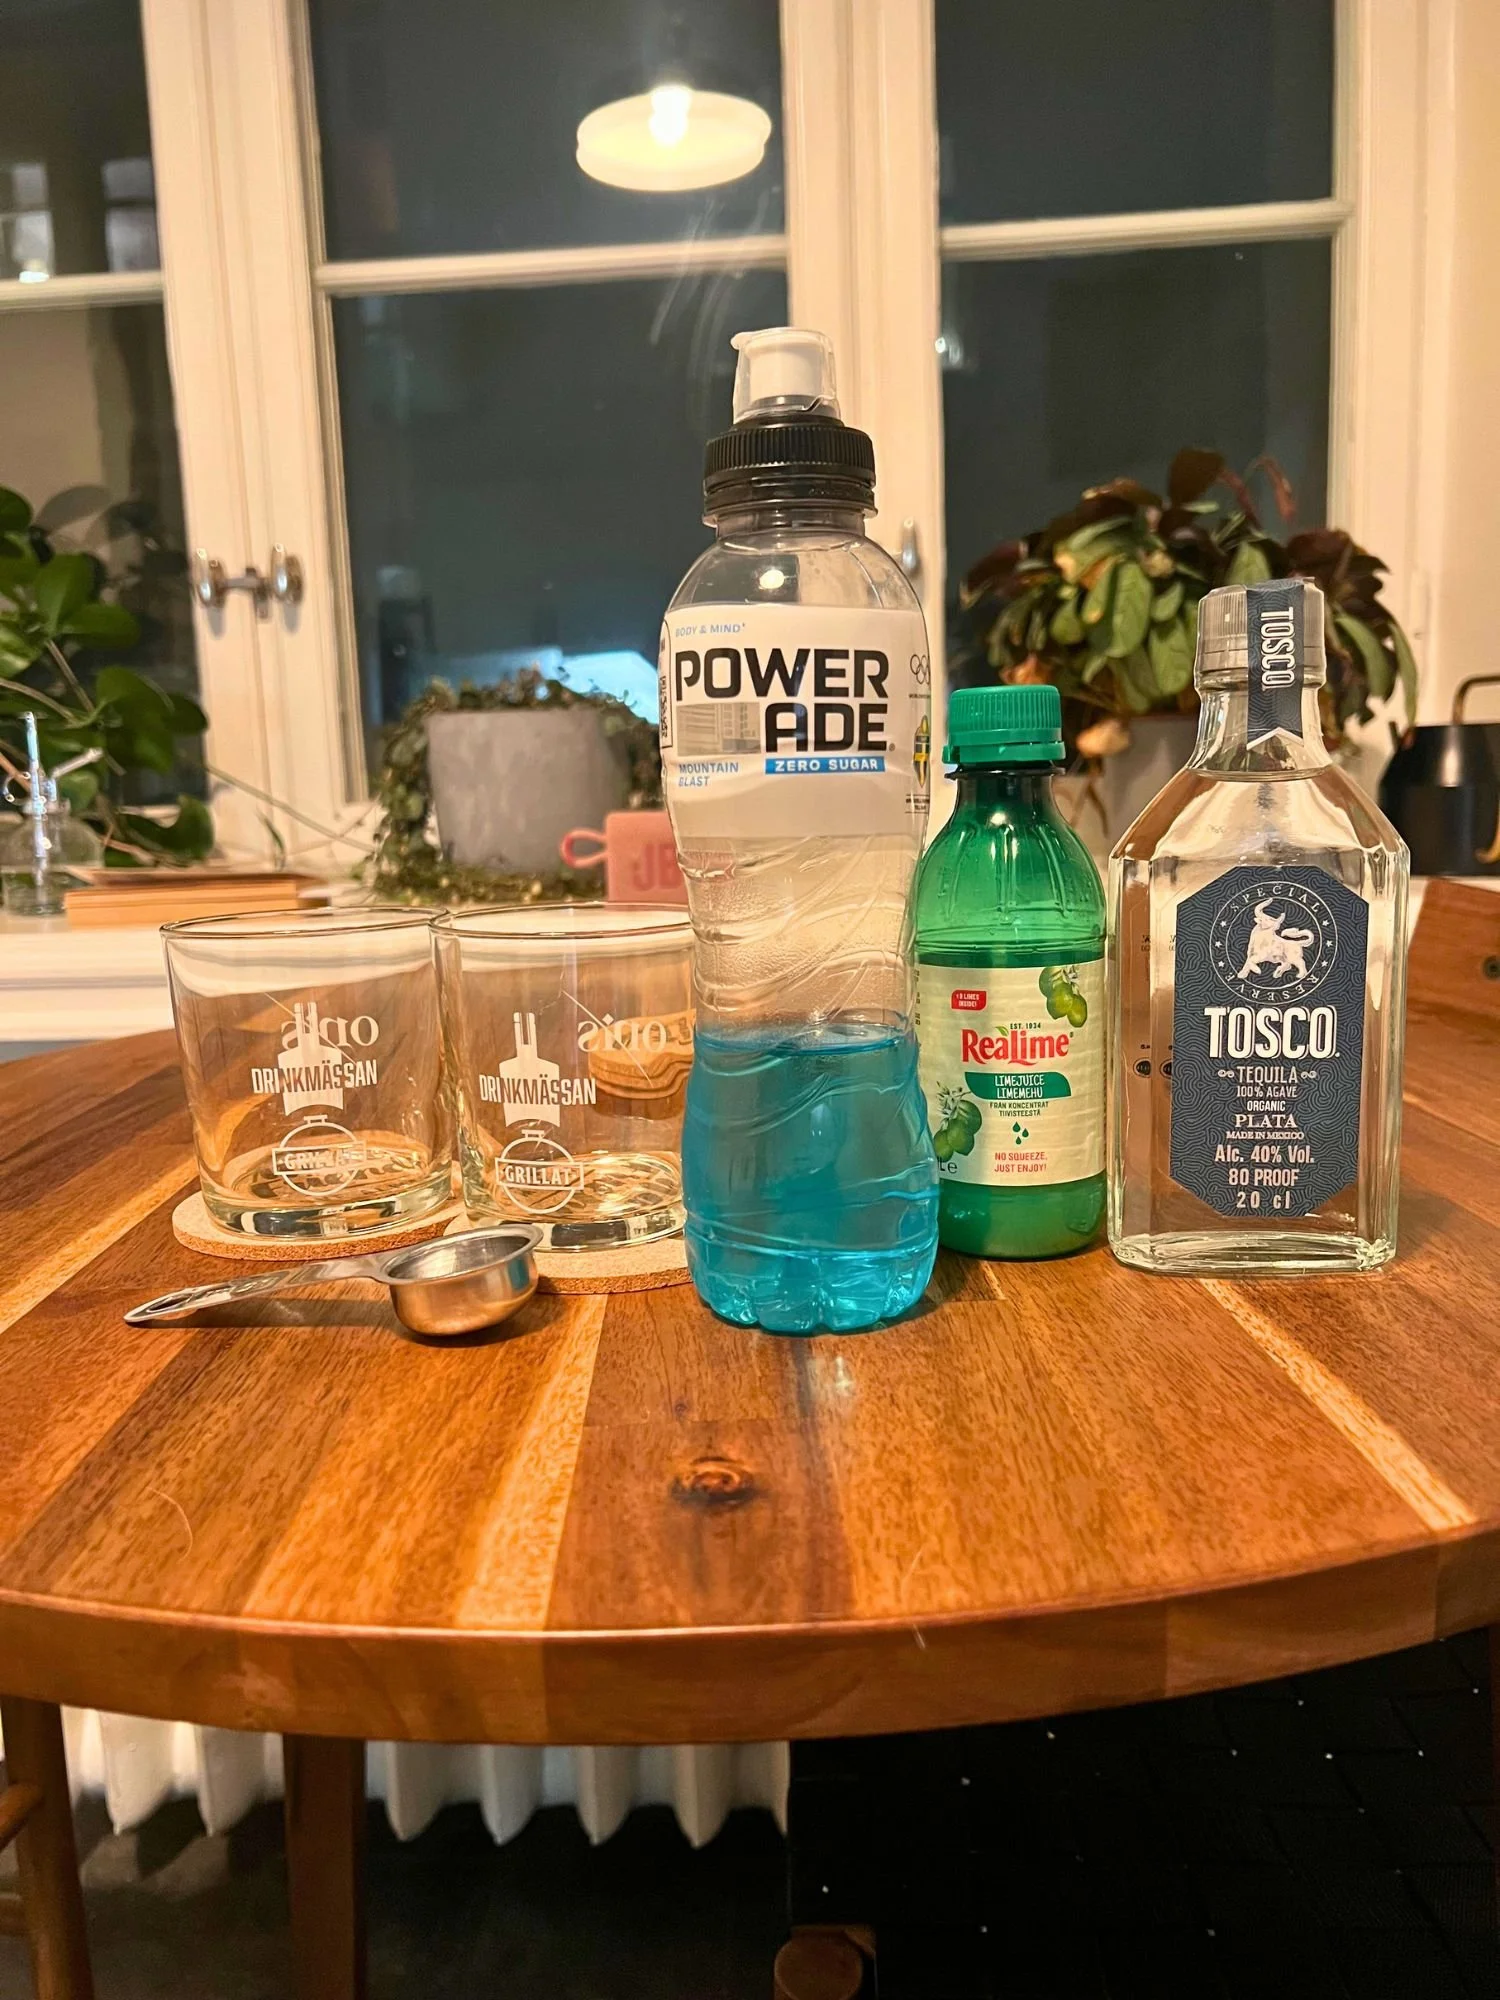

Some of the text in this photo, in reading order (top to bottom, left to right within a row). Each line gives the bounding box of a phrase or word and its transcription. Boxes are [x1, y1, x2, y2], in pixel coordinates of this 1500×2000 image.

[675, 626, 697, 638] BODY
[699, 624, 707, 634] &
[1261, 606, 1296, 690] TOSCO
[675, 647, 890, 701] POWER
[764, 702, 889, 753] ADE
[679, 762, 739, 774] MOUNTAIN
[774, 759, 878, 773] ZERO SUGAR
[1230, 885, 1320, 912] SPECIAL
[1225, 972, 1320, 1002] RESERVE
[251, 1059, 378, 1094] DRINKMÄSSAN
[994, 1074, 1046, 1087] LIMEJUICE
[1236, 1065, 1299, 1086] TEQUILA
[479, 1073, 597, 1106] DRINKMÄSSAN
[996, 1087, 1043, 1099] LIMEMEHU
[1236, 1086, 1298, 1098] 100% AGAVE
[1008, 1101, 1049, 1109] KONCENTRAT
[1246, 1100, 1286, 1112] ORGANIC
[1234, 1113, 1299, 1128] PLATA
[1226, 1131, 1305, 1140] MADE IN MEXICO
[994, 1152, 1007, 1161] NO
[1214, 1144, 1316, 1164] Alc. 40% Vol.
[505, 1164, 571, 1187] GRILLAT
[994, 1163, 1047, 1173] JUST ENJOY!
[1228, 1168, 1300, 1187] 80 PROOF
[1236, 1191, 1291, 1210] 20 cl
